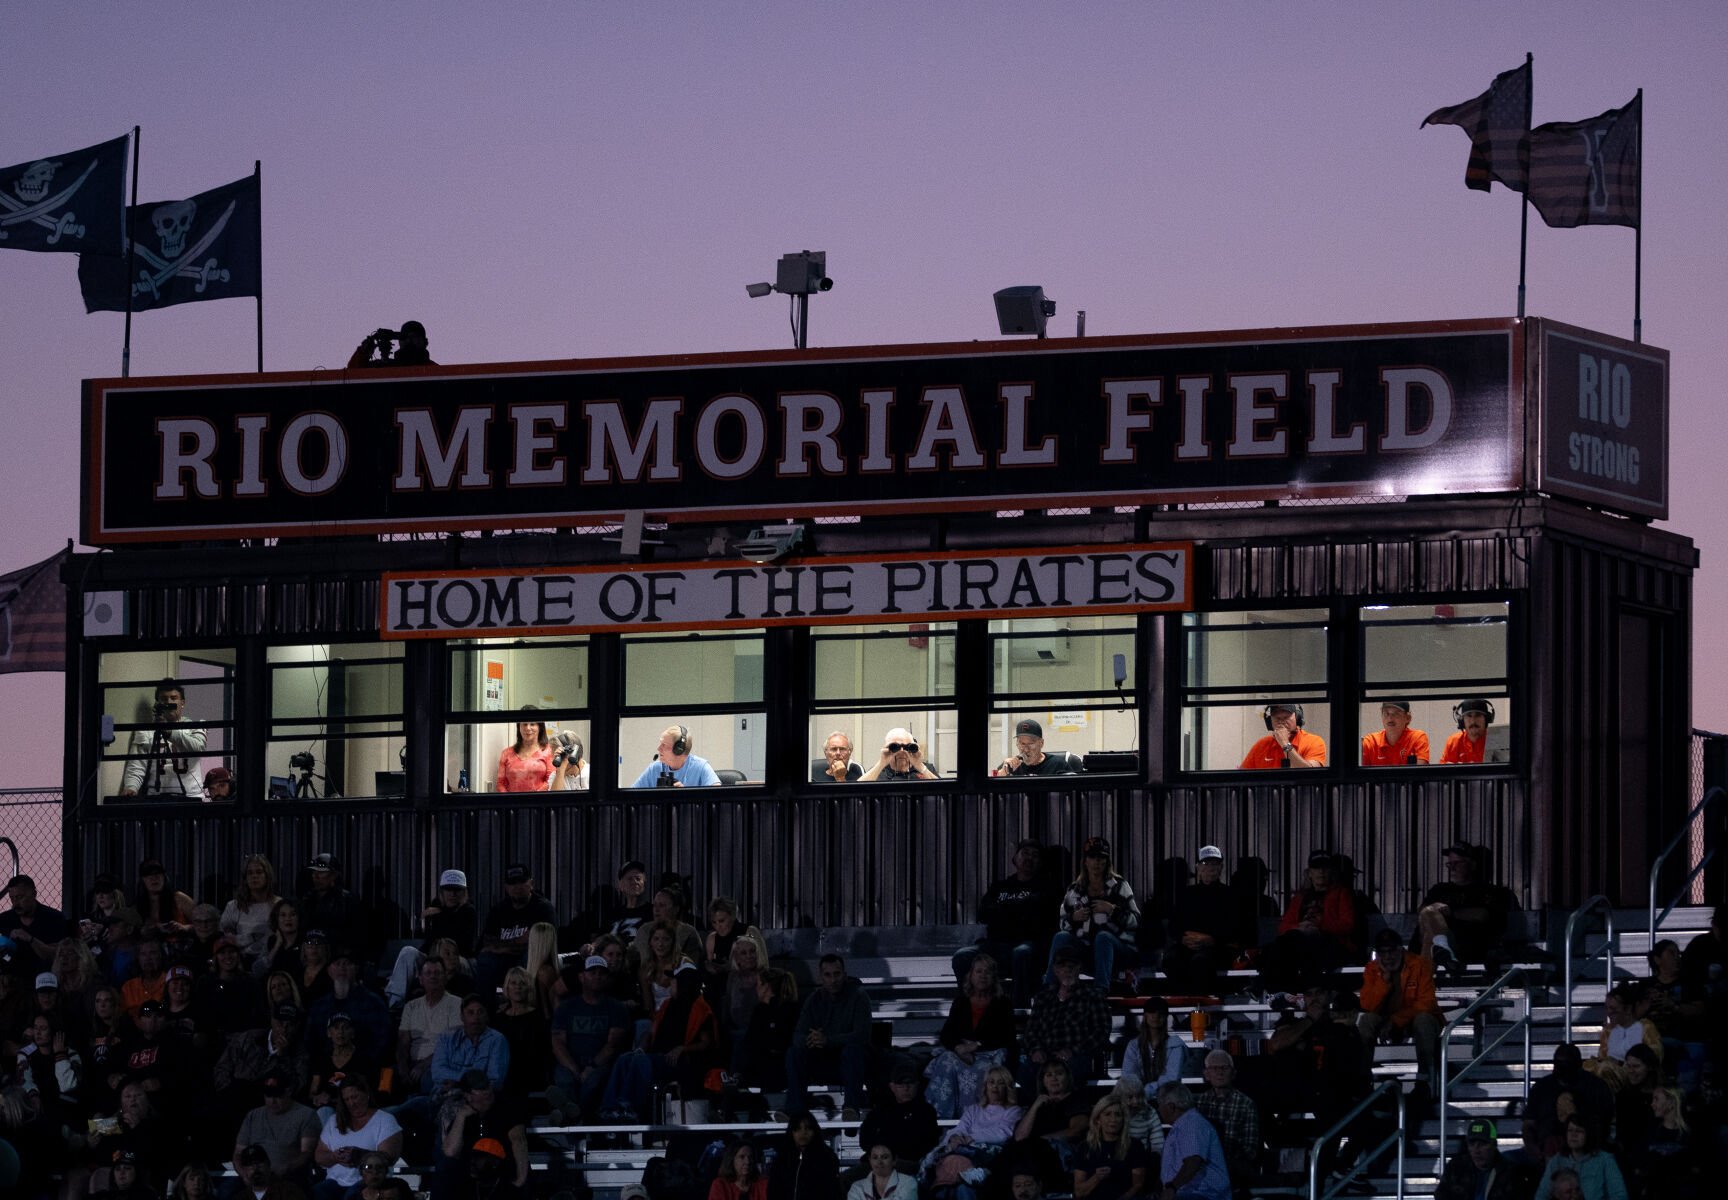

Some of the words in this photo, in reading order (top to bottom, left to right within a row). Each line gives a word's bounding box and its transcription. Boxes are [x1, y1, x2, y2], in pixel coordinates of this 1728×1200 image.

[1579, 353, 1632, 429] RIO
[153, 409, 351, 503] RIO
[391, 380, 1061, 494] MEMORIAL
[1099, 364, 1457, 465] FIELD
[1568, 430, 1641, 486] STRONG
[394, 575, 576, 631] HOME
[599, 571, 687, 623] OF
[713, 564, 855, 619] THE
[881, 551, 1180, 614] PIRATES
